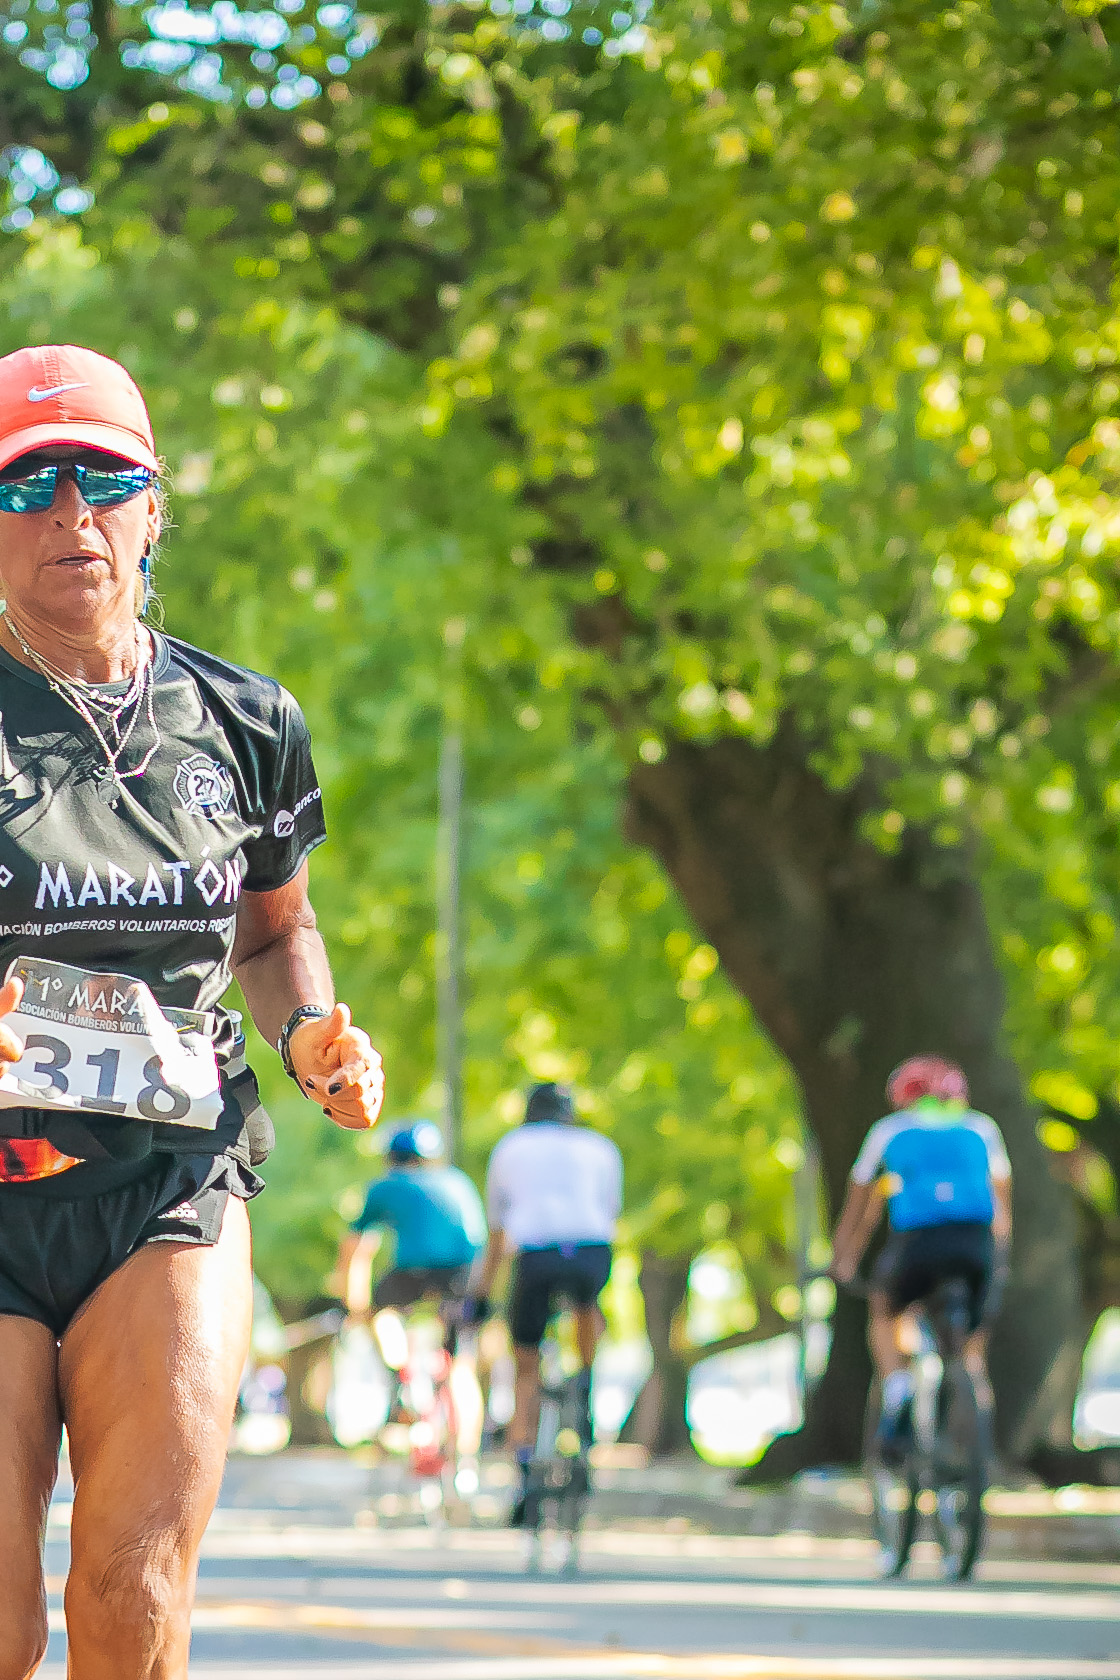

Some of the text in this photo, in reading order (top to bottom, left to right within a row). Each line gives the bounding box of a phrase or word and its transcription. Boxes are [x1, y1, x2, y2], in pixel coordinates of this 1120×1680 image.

[193, 774, 215, 797] 27
[34, 844, 241, 909] MARATÓN
[43, 919, 117, 936] BOMBEROS
[119, 919, 207, 933] VOLUNTARIOS
[68, 983, 144, 1017] MARA
[67, 1013, 119, 1032] BOMBEROS
[18, 1034, 191, 1121] 318
